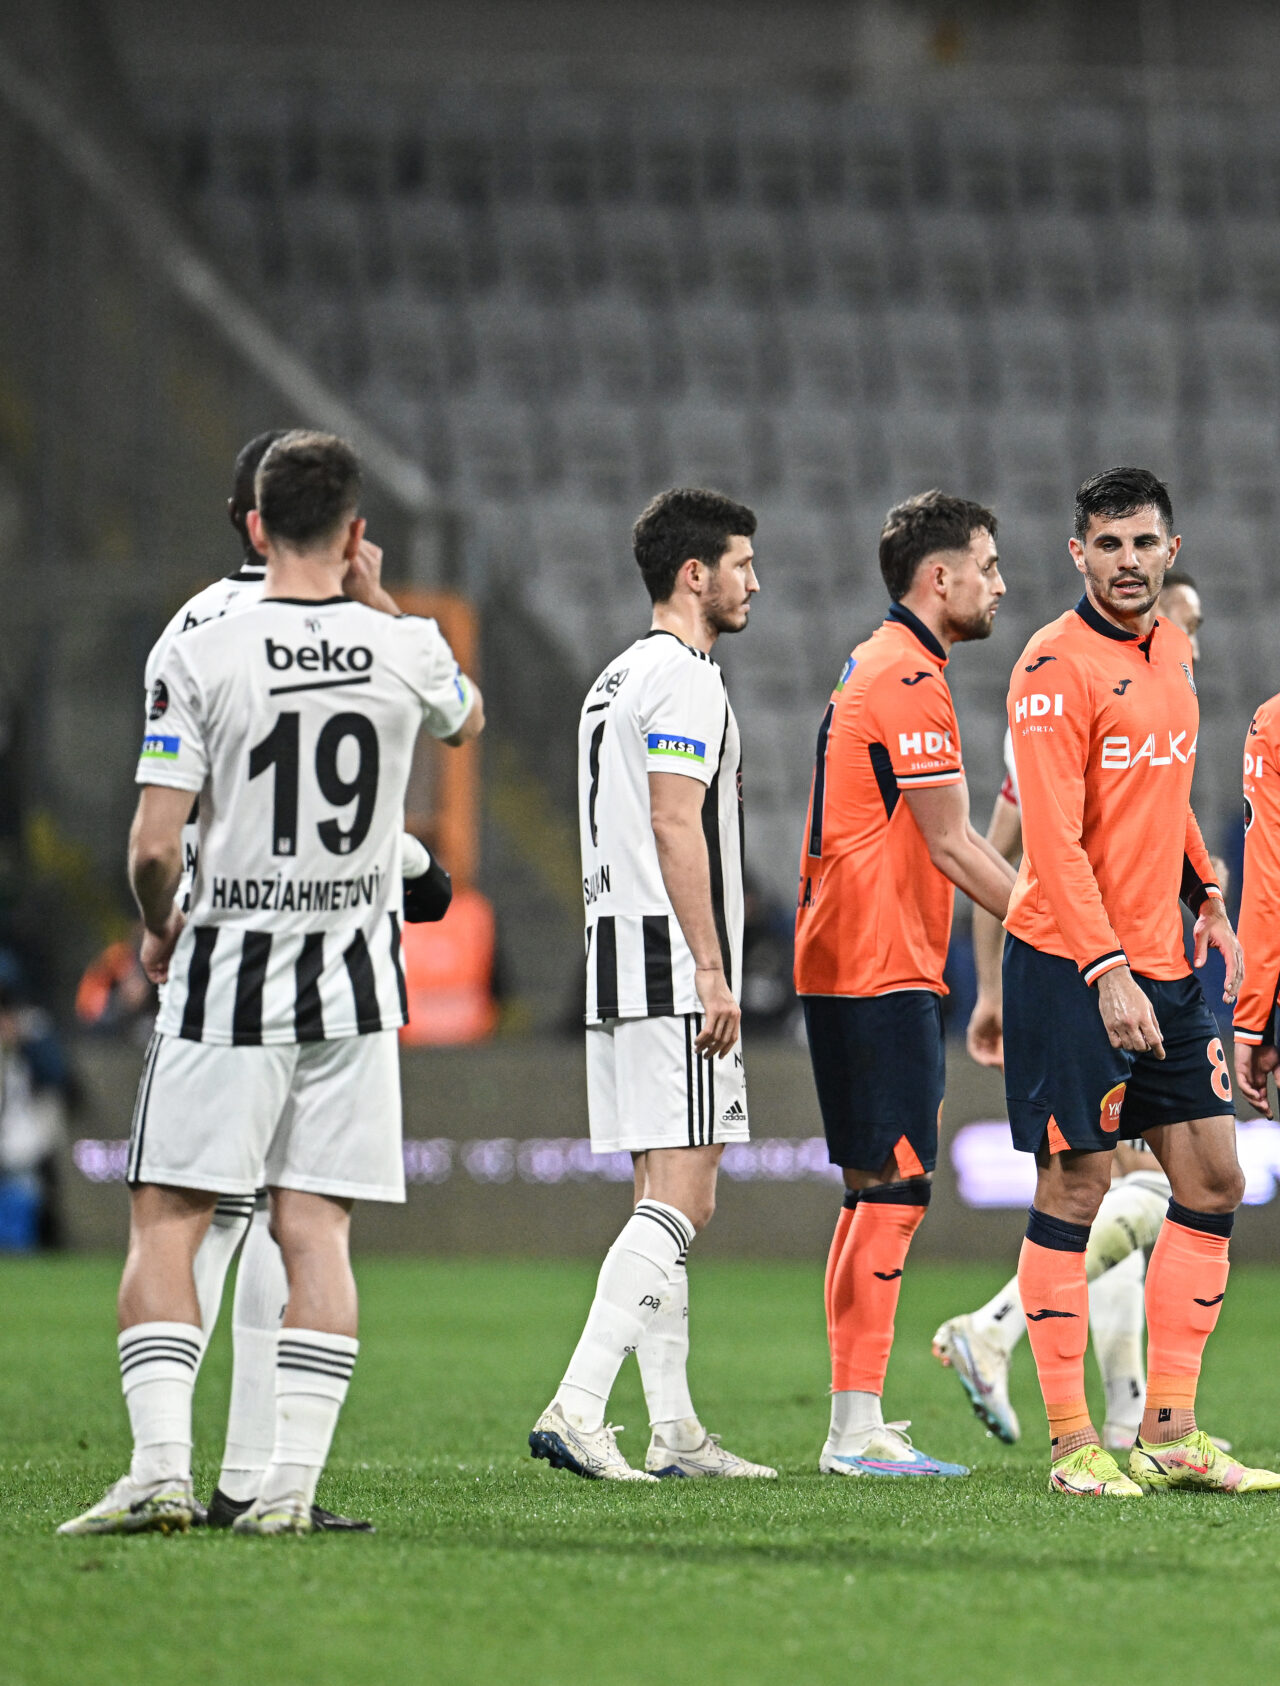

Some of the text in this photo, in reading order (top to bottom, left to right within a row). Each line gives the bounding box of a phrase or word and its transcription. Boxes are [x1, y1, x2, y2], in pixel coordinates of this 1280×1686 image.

[265, 638, 373, 673] beko
[1015, 693, 1064, 724] HDI
[657, 738, 696, 755] aksa
[898, 731, 952, 756] HDI
[1101, 729, 1198, 769] BALKA
[1244, 752, 1263, 778] DI
[248, 710, 380, 857] 19
[1206, 1037, 1233, 1102] 8
